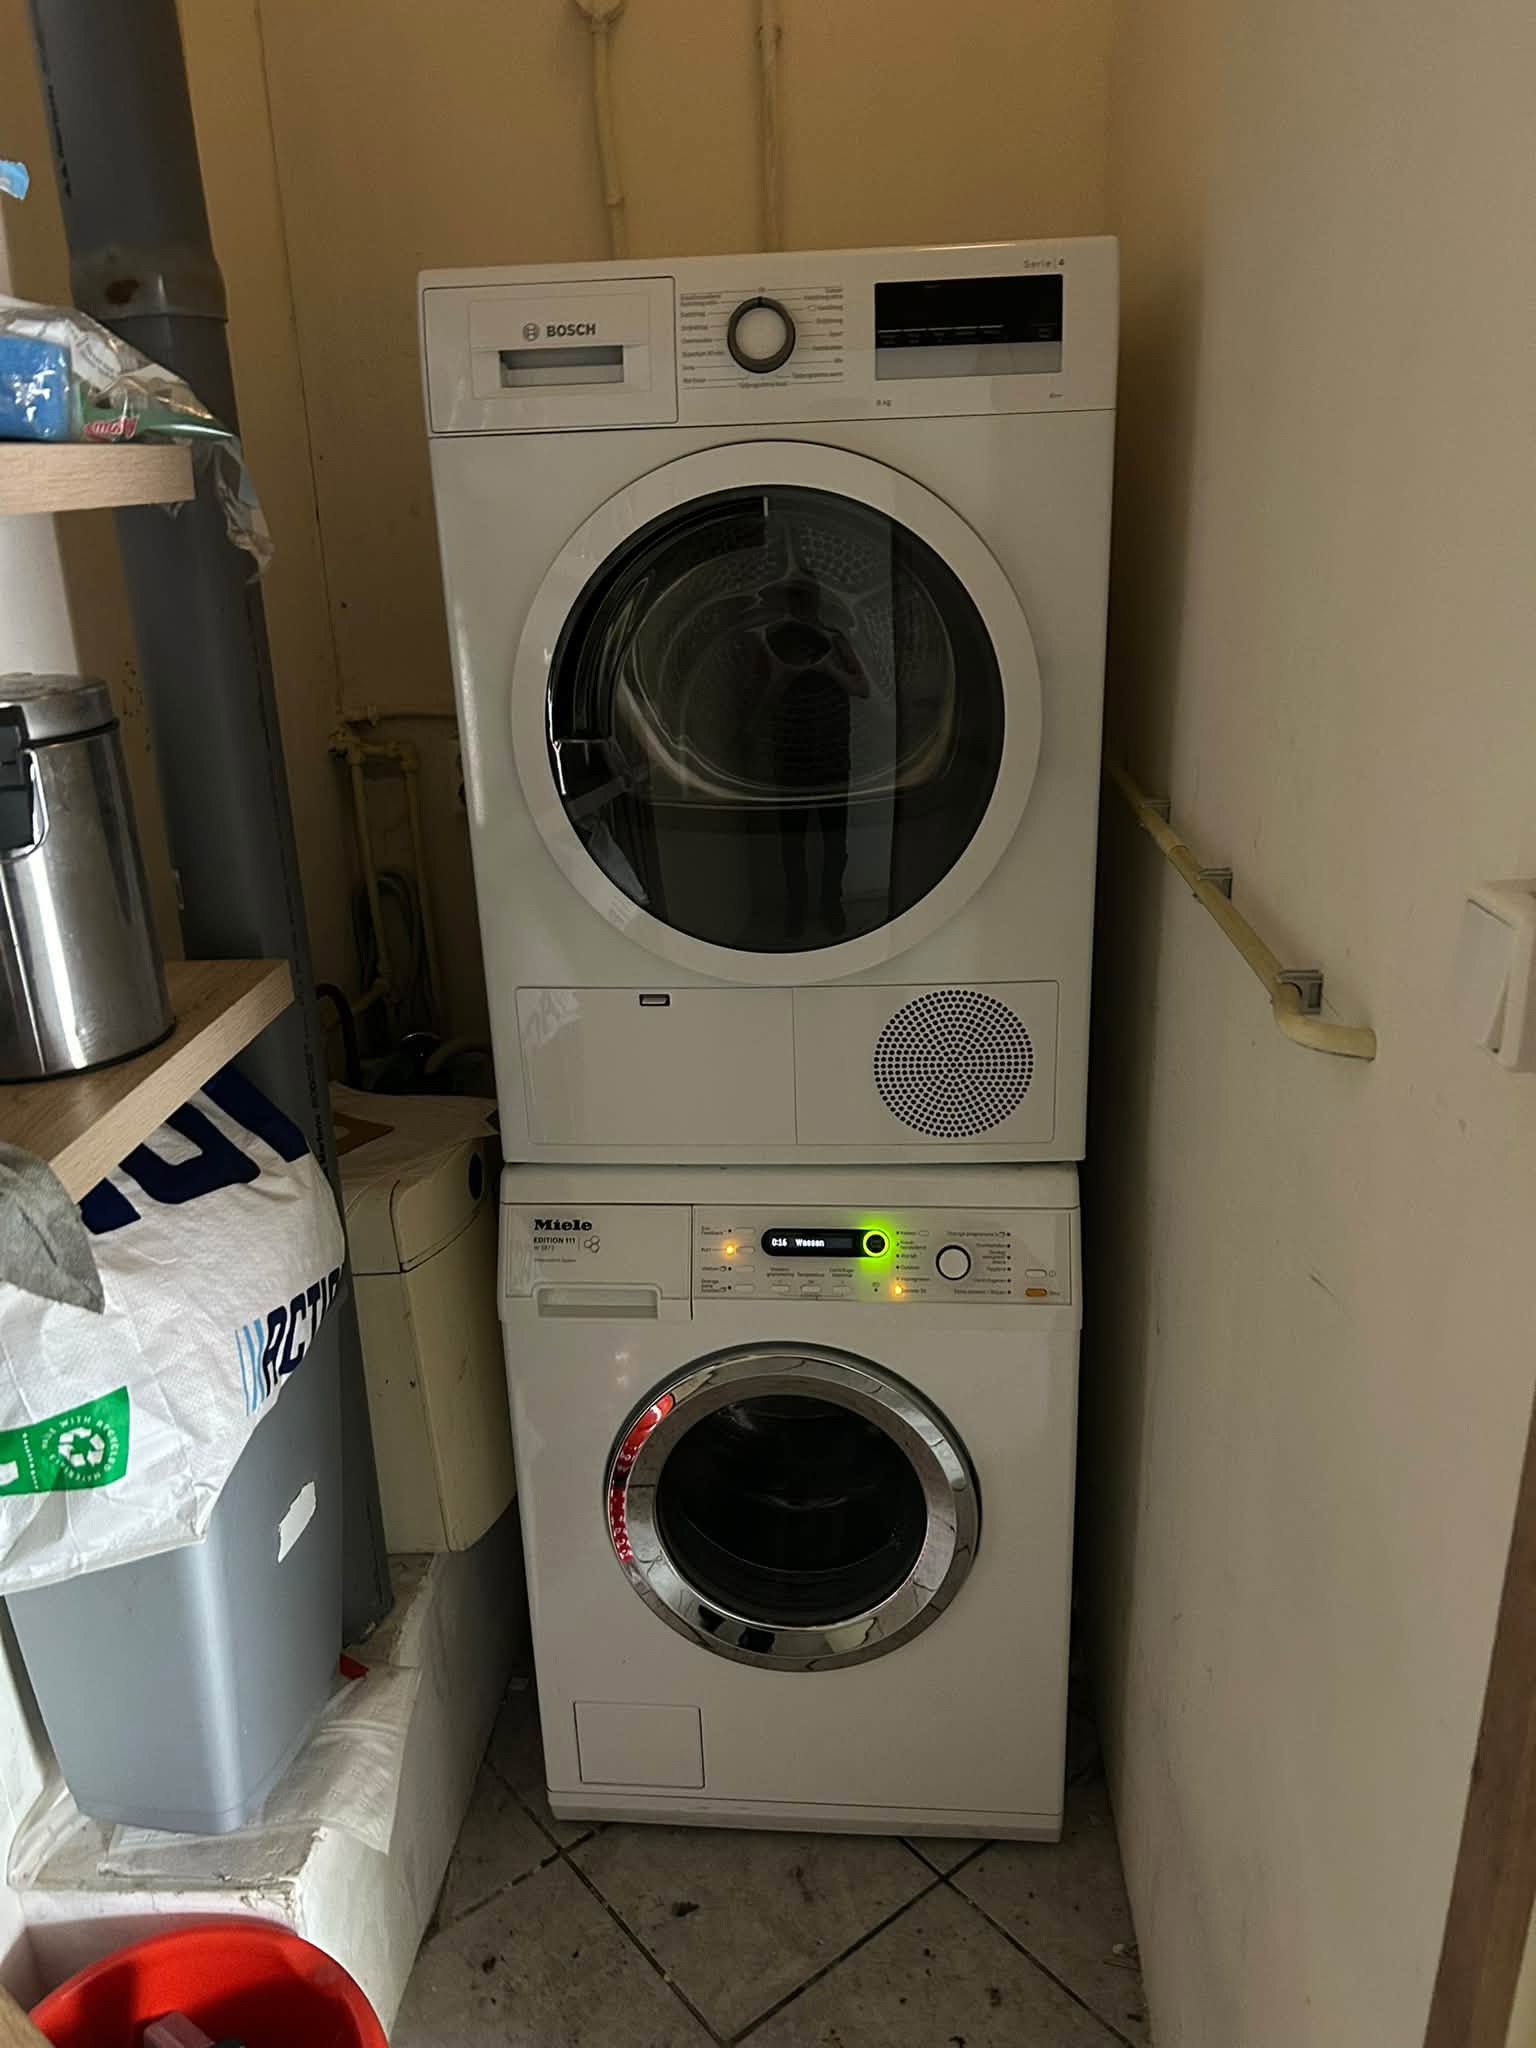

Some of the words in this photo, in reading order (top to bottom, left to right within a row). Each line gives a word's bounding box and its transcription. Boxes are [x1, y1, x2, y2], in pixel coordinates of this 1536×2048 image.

[546, 323, 596, 337] BOSCH
[534, 1219, 593, 1231] Miele
[533, 1236, 564, 1244] EDITION
